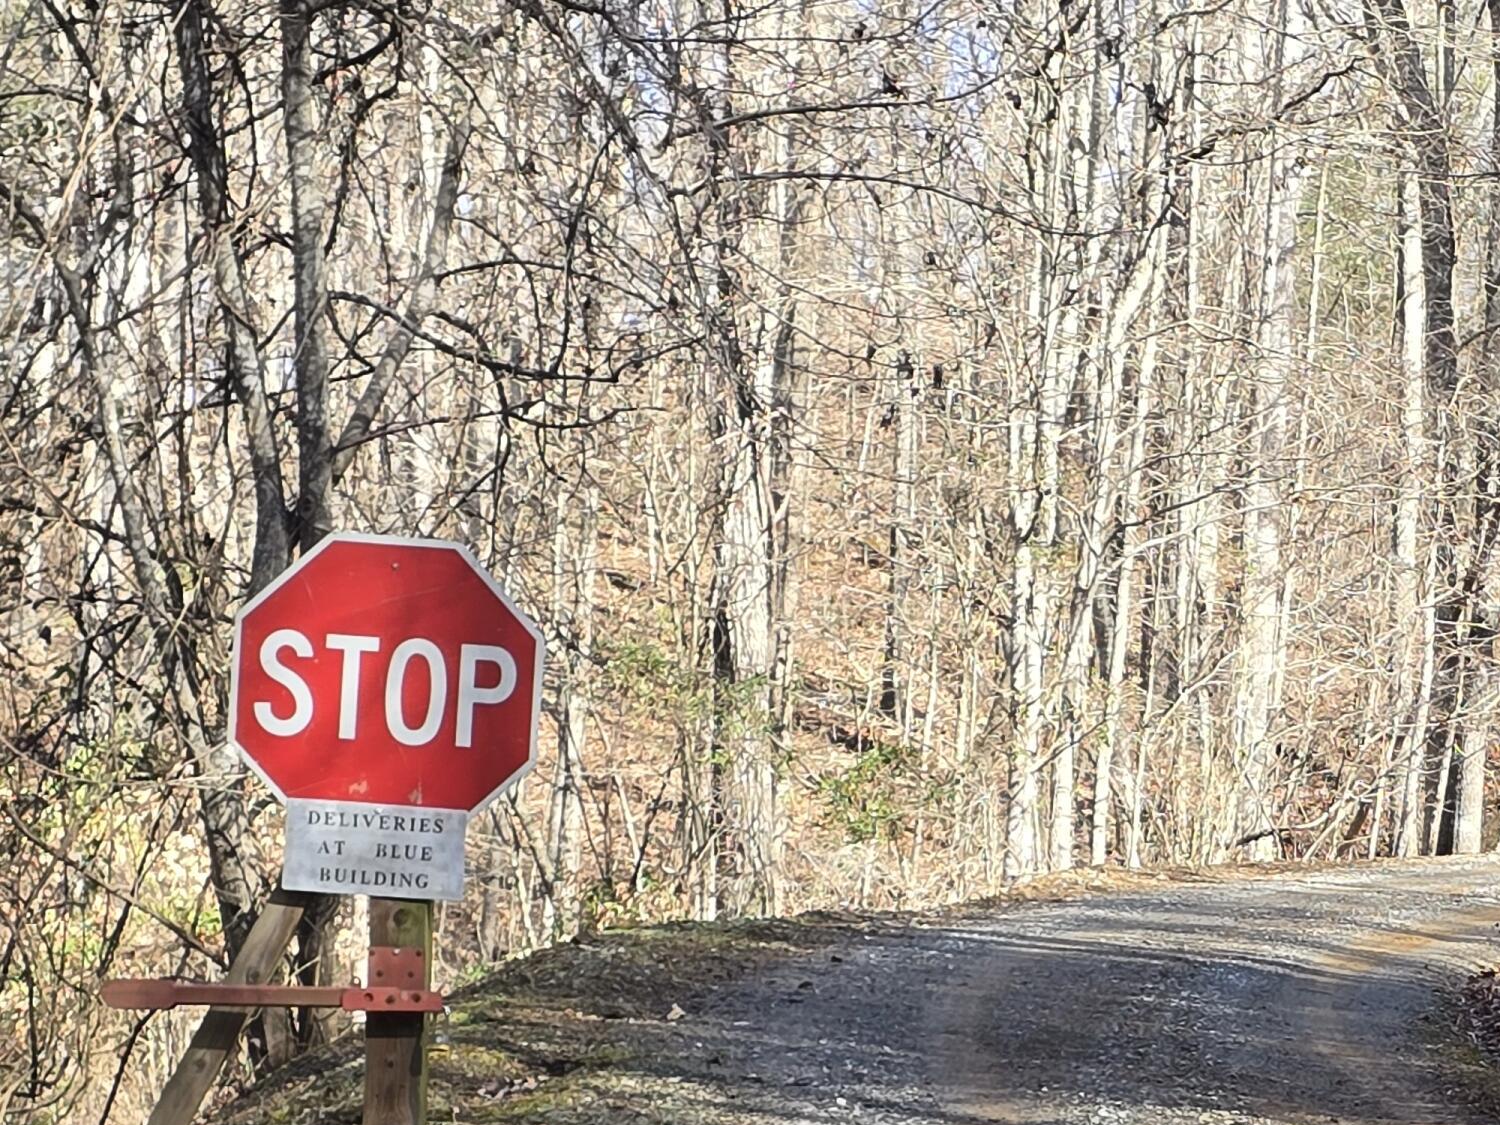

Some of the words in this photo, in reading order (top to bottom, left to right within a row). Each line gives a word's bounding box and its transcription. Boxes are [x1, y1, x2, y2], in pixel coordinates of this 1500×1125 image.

[253, 629, 517, 748] STOP
[307, 810, 444, 834] DELIVERIES
[317, 840, 346, 856] AT
[375, 843, 433, 862] BLUE
[319, 867, 430, 889] BUILDING
